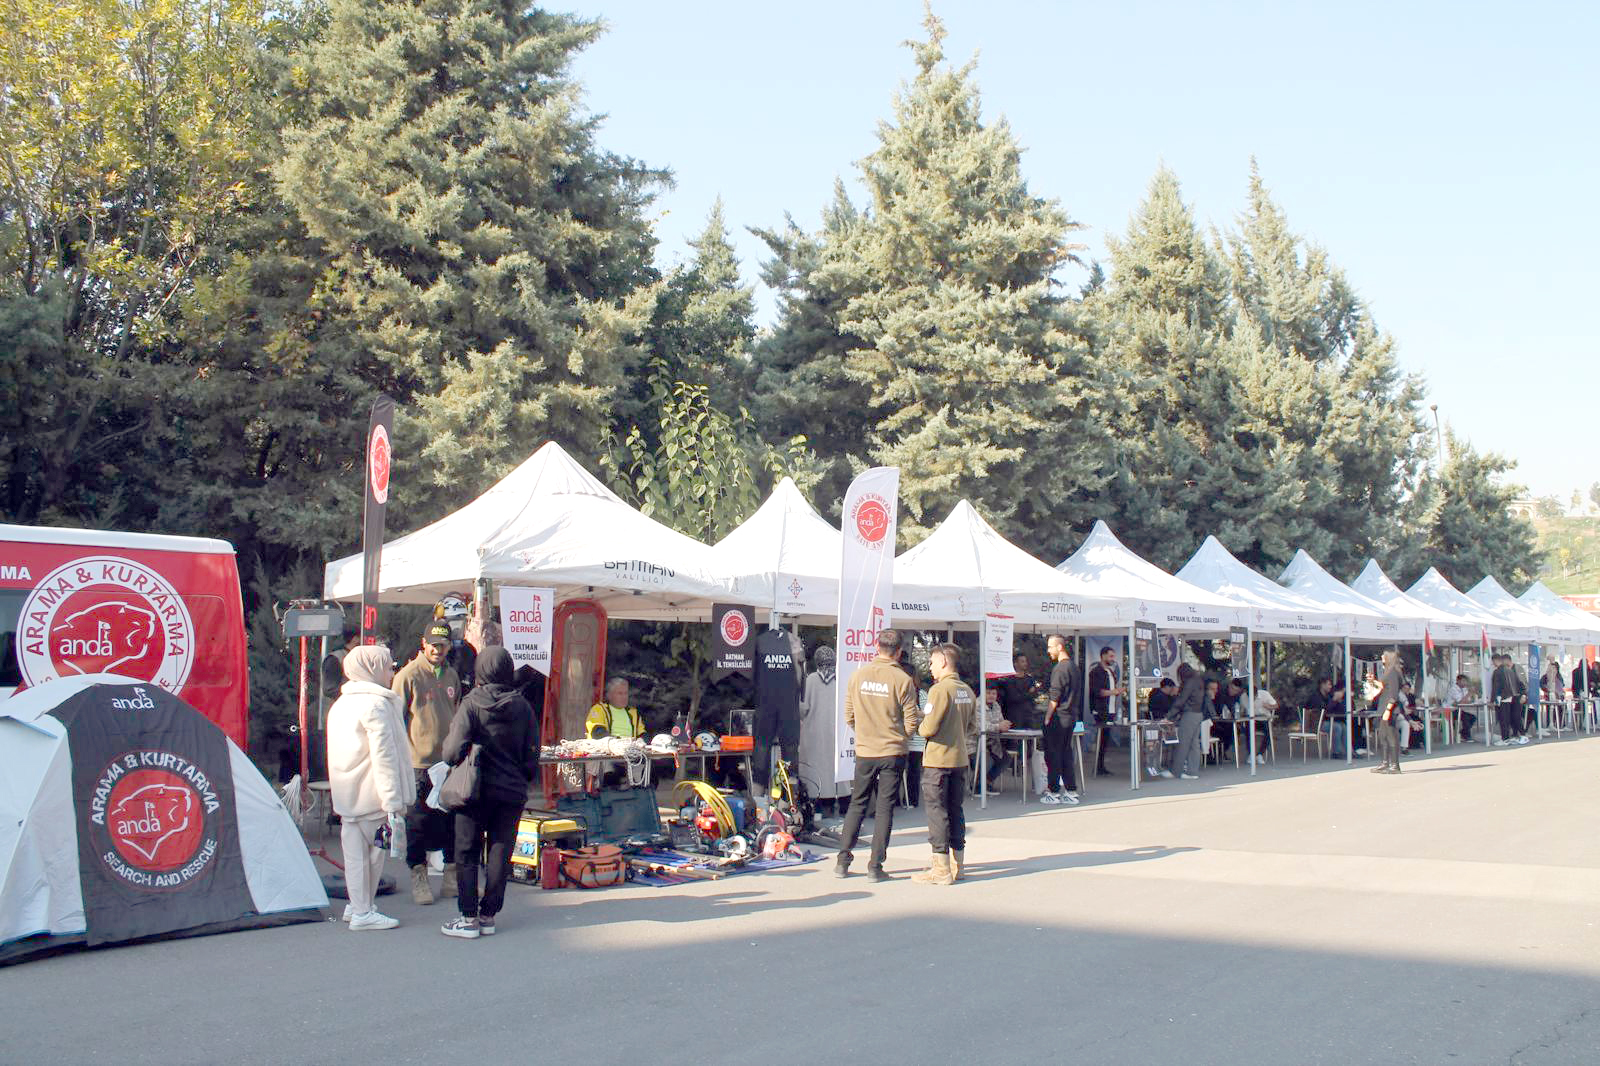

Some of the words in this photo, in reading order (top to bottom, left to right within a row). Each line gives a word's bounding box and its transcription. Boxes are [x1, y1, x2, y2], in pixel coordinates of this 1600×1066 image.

[0, 566, 32, 580] MA
[26, 577, 74, 656] ARAMA
[75, 567, 93, 583] &
[102, 564, 185, 657] KURTARMA
[509, 600, 543, 623] anda
[891, 602, 900, 610] EL
[1041, 601, 1082, 614] BATMAN
[510, 625, 542, 633] DERNEĞİ
[60, 624, 113, 656] anda
[514, 643, 538, 651] BATMAN
[764, 655, 792, 664] ANDA
[861, 681, 889, 693] ANDA
[112, 689, 155, 709] anda
[91, 763, 125, 825] ARAMA
[124, 754, 139, 769] &
[140, 752, 220, 814] KURTARMA
[117, 804, 161, 835] anda
[103, 851, 152, 886] SEARCH
[155, 874, 181, 887] AND
[181, 839, 218, 880] RESCUE
